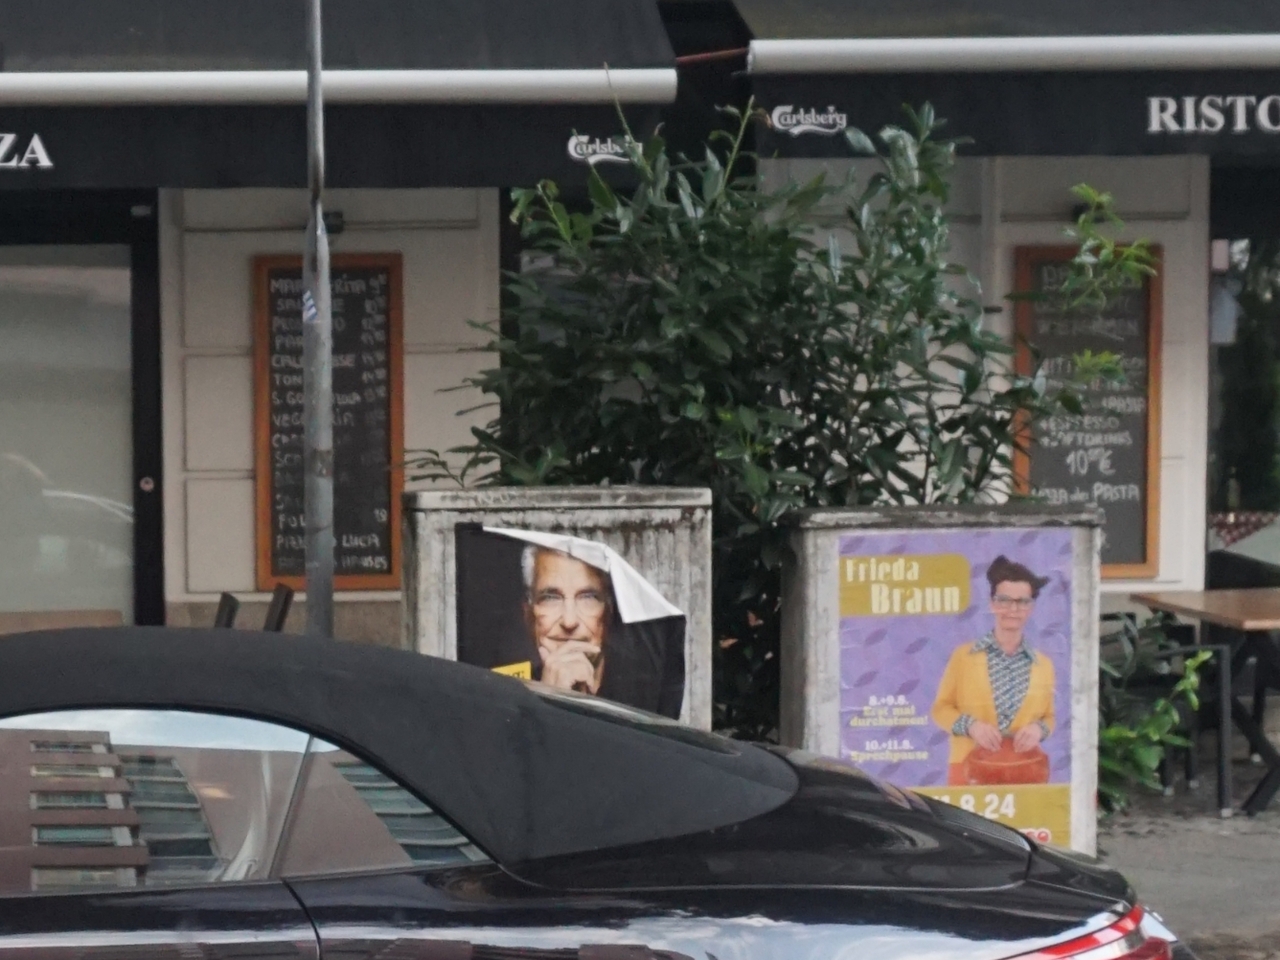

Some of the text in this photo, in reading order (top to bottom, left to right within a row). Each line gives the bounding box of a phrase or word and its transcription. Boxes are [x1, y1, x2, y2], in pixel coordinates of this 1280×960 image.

[771, 104, 847, 134] Carlsberg
[1093, 481, 1140, 502] PASTA
[846, 557, 920, 582] Frieda
[871, 583, 960, 614] Braun
